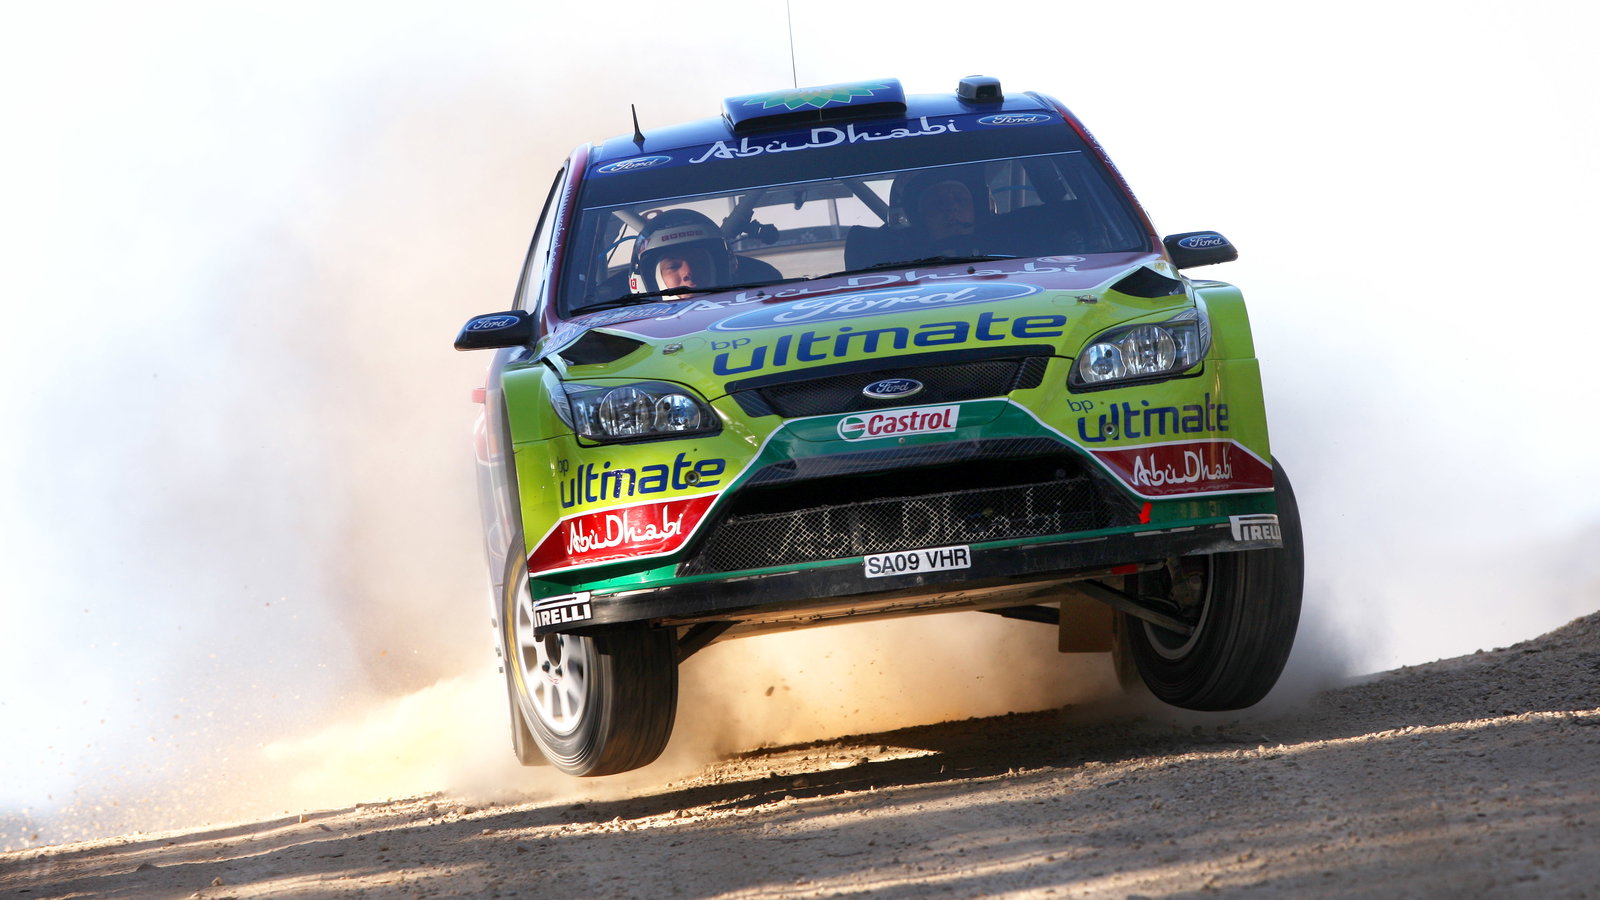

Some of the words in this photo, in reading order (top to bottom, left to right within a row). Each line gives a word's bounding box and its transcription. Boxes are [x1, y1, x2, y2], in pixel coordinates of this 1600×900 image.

[988, 115, 1038, 124] Ford
[610, 158, 659, 172] Ford
[1189, 236, 1223, 248] Ford
[773, 286, 978, 323] Ford
[473, 317, 510, 330] Ford
[711, 337, 751, 351] bp
[712, 312, 1067, 376] ultimate
[876, 380, 910, 393] Ford
[1067, 399, 1094, 413] bp
[867, 408, 951, 436] Castrol
[1077, 392, 1229, 443] ultimate
[560, 447, 726, 509] ultimate
[867, 552, 920, 575] SA09
[925, 547, 968, 569] VHR
